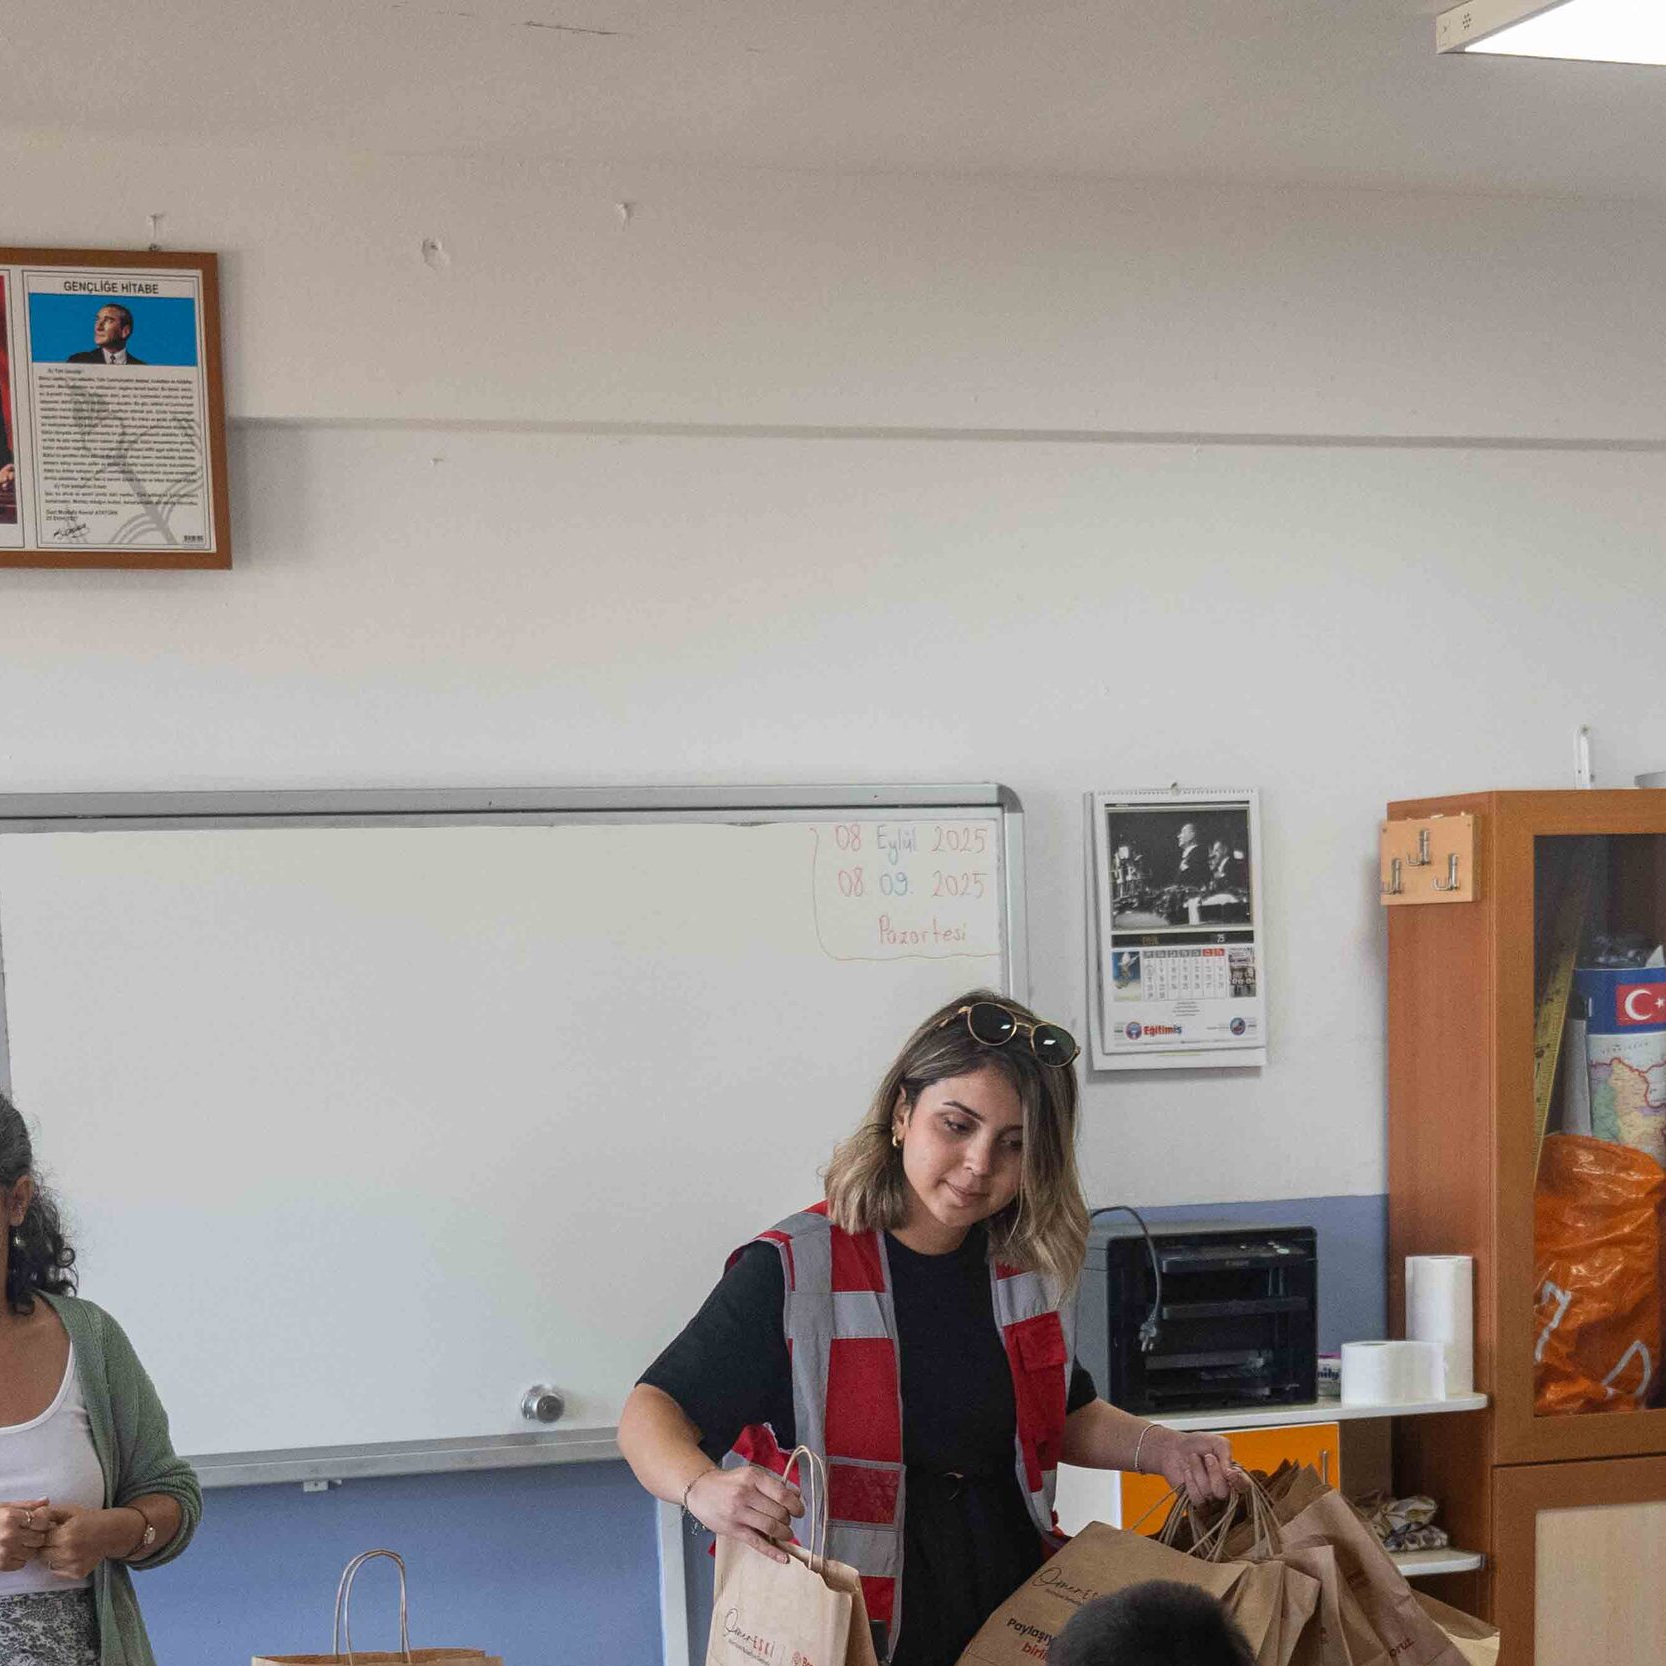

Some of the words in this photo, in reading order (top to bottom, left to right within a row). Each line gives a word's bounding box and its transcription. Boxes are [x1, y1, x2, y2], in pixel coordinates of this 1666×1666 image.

[63, 278, 118, 294] GENÇLİĞE
[121, 281, 160, 295] HİTABE
[835, 824, 861, 851] 08
[877, 824, 917, 866] Eylül
[931, 826, 988, 854] 2025
[932, 870, 989, 899] 2025
[878, 914, 967, 945] Pazartesi
